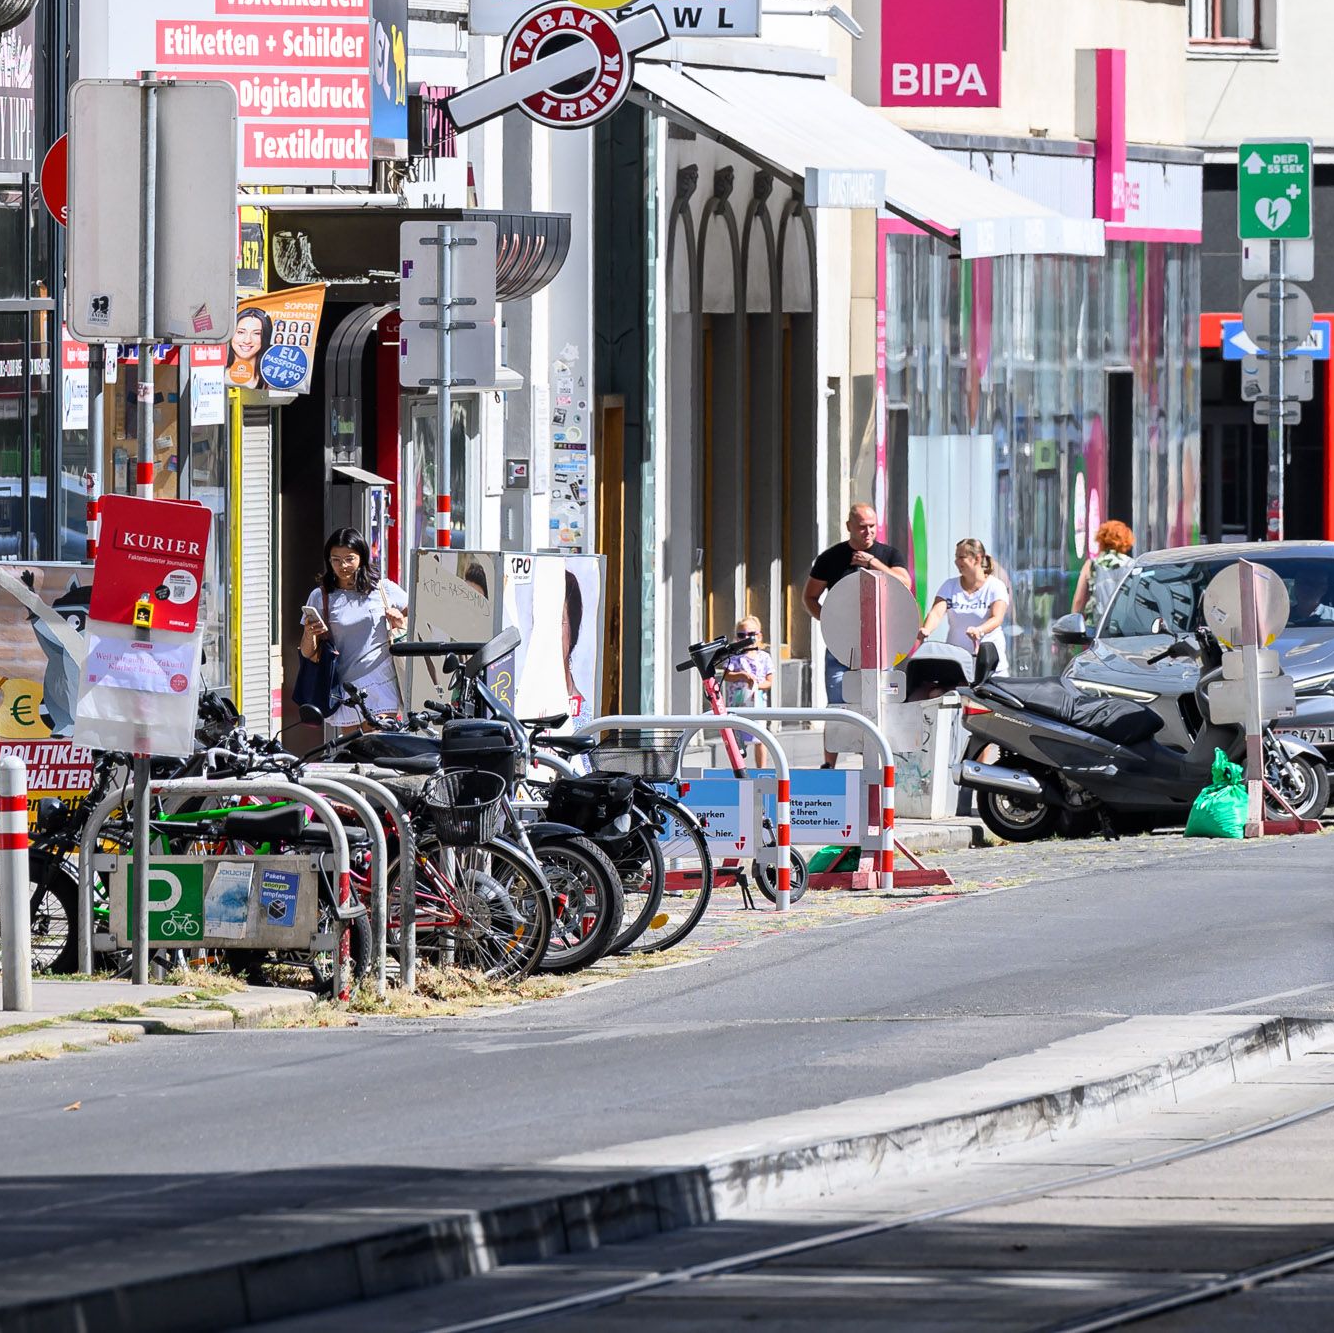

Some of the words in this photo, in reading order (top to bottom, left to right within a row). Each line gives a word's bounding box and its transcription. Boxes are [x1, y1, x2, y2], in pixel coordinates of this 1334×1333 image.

[164, 25, 258, 56] Etiketten
[283, 28, 364, 58] Schilder
[513, 10, 599, 61] TABAK
[540, 53, 620, 118] TRAFIK
[891, 63, 987, 96] BIPA
[240, 81, 365, 118] Digitaldruck
[253, 130, 368, 159] Textildruck
[1272, 154, 1298, 164] DEFI
[1267, 164, 1281, 174] 55
[1282, 164, 1304, 174] SEK
[284, 302, 319, 310] SOFORT
[279, 346, 298, 361] EU
[264, 354, 306, 373] PASSFOTOS
[123, 532, 200, 556] KURIER
[789, 799, 803, 807] itte
[804, 799, 832, 810] parken
[696, 810, 725, 820] parken
[822, 817, 840, 826] hier.
[715, 829, 734, 838] hier.
[265, 872, 286, 881] Pakete
[263, 891, 296, 900] empfangen
